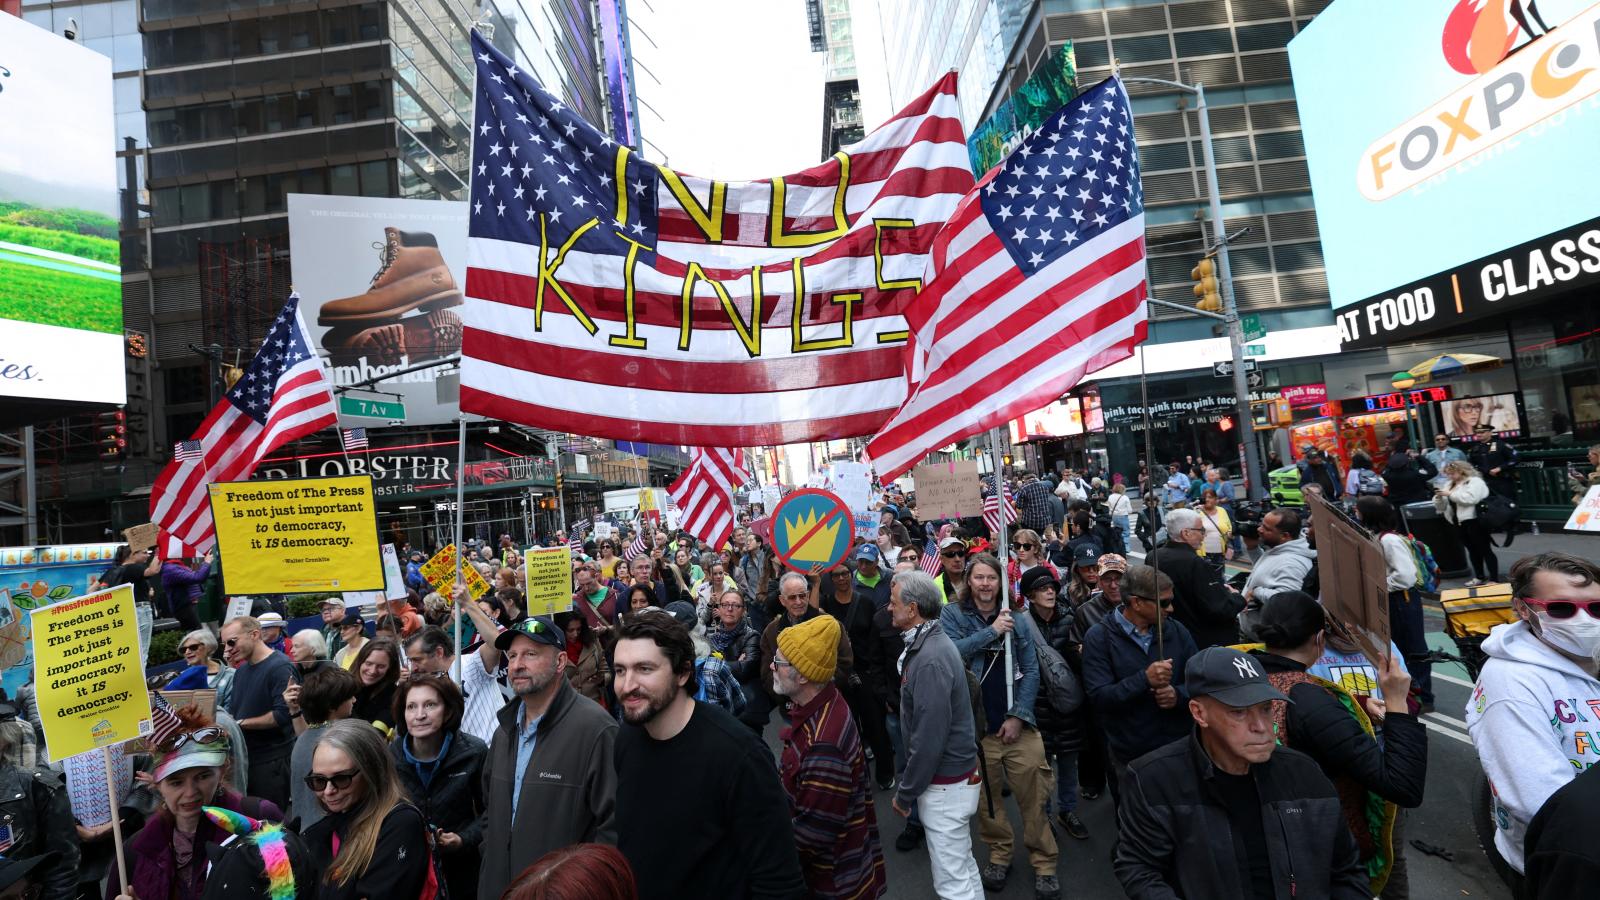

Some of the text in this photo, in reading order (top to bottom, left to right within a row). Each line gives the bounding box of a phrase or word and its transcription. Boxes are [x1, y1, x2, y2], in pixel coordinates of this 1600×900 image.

[533, 211, 923, 359] KINGS
[1366, 286, 1436, 336] FOOD
[1285, 387, 1304, 400] pink
[1307, 386, 1325, 395] taco
[361, 403, 367, 414] 7
[1148, 401, 1170, 418] pink
[1172, 401, 1192, 410] taco
[1193, 396, 1215, 413] pink
[1217, 396, 1237, 405] taco
[1103, 406, 1125, 424] pink
[298, 456, 452, 480] LOBSTER
[226, 486, 365, 503] Freedom of The Press
[232, 502, 363, 519] is not just important
[256, 520, 346, 533] to democracy,
[251, 536, 353, 549] it IS democracy.
[48, 604, 120, 632] Freedom of
[47, 618, 124, 647] The Press is
[63, 636, 112, 658] not just
[46, 645, 129, 677] important to
[1232, 656, 1260, 679] NY
[1316, 657, 1339, 665] AKE
[51, 662, 126, 690] democracy,
[76, 681, 107, 697] it IS
[57, 691, 133, 718] democracy.
